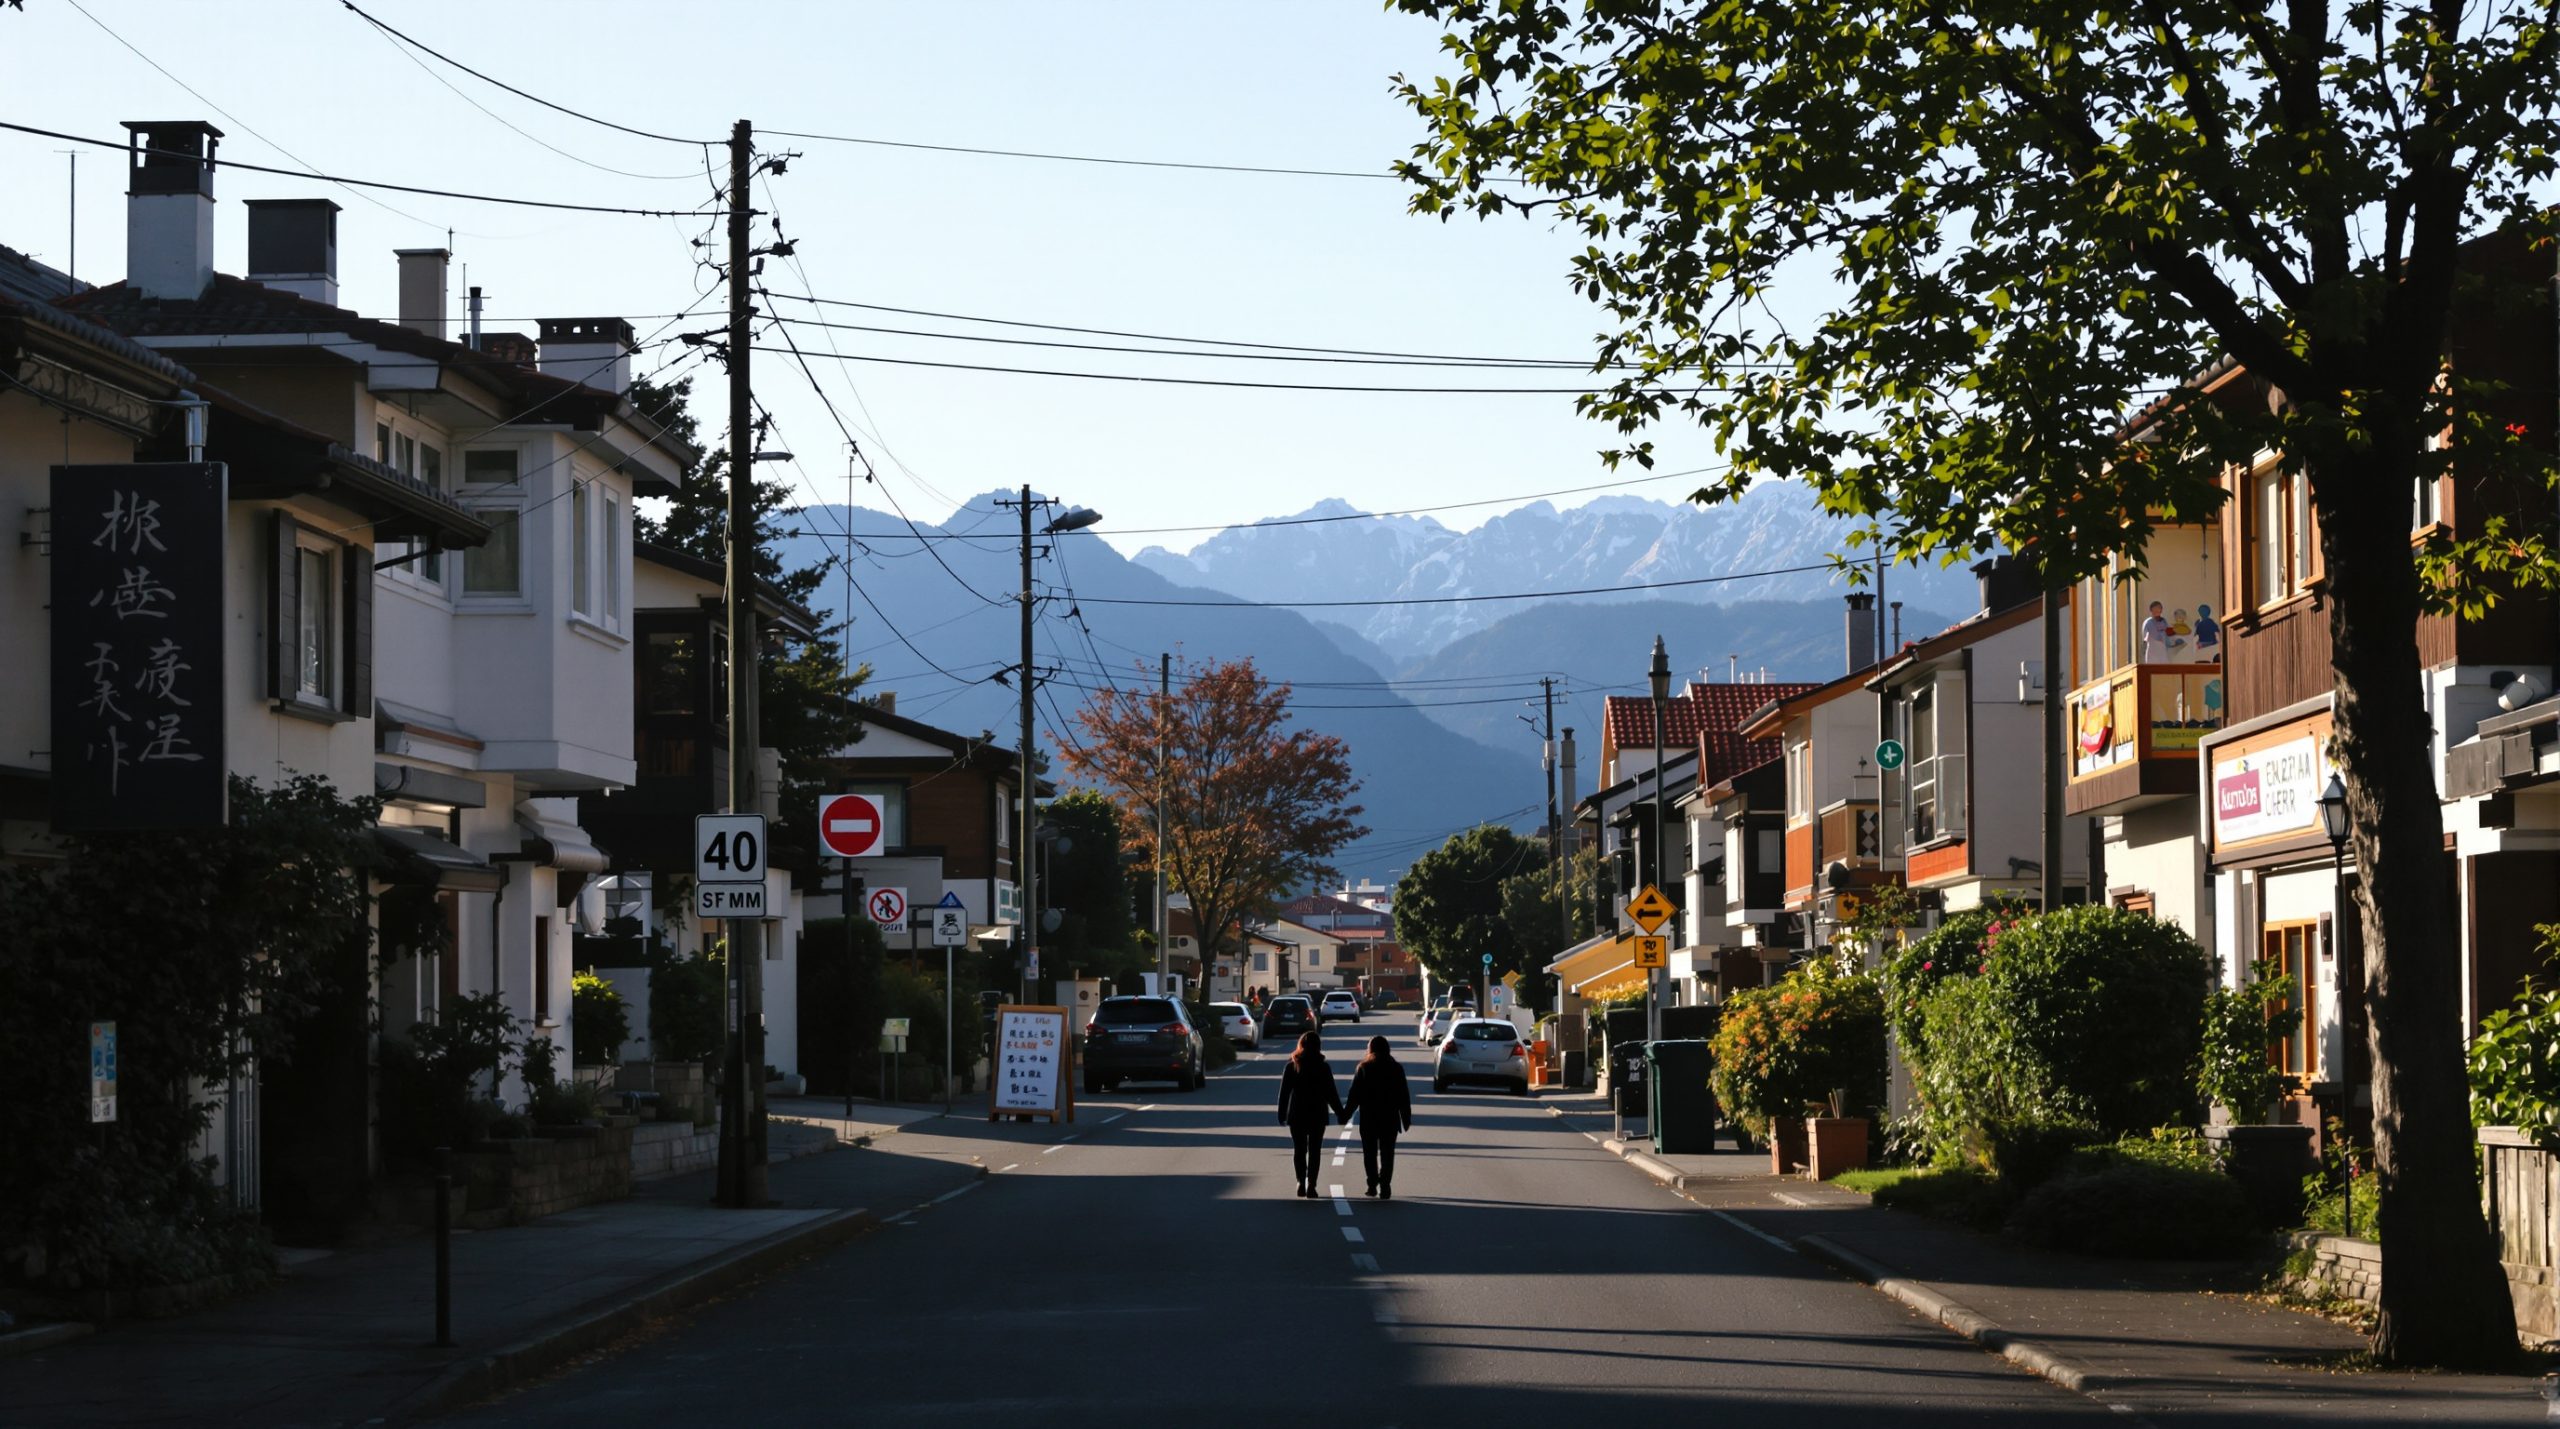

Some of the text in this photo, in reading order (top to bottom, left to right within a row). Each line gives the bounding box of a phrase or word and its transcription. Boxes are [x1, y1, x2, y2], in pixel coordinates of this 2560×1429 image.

[703, 831, 757, 872] 40
[702, 891, 761, 908] SF MM
